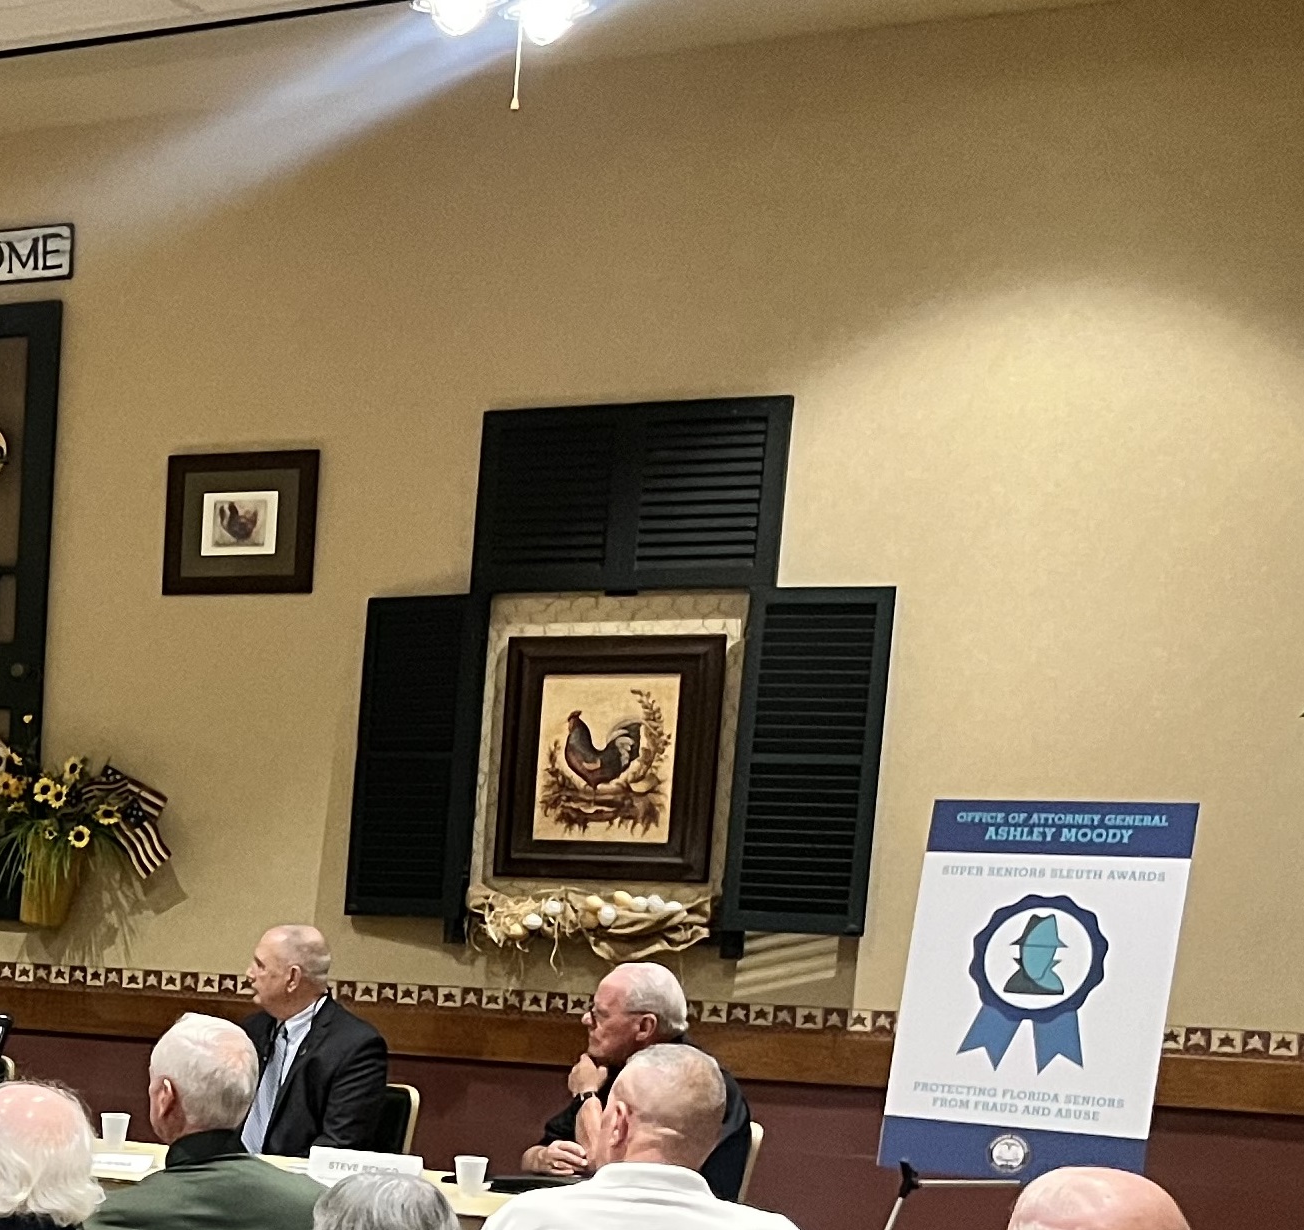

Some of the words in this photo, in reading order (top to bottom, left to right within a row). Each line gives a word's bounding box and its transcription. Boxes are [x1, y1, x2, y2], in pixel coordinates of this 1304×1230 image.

[956, 812, 1004, 823] OFFICE
[1008, 813, 1027, 824] OF
[1028, 813, 1101, 825] ATTORNEY
[1104, 815, 1169, 827] GENERAL
[984, 827, 1056, 842] ASHLEY
[1060, 828, 1133, 844] MOODY
[942, 865, 984, 877] SUPER
[987, 866, 1046, 878] SENIORS
[1050, 868, 1102, 880] SLEUTH
[1106, 869, 1166, 882] AWARDS
[913, 1081, 997, 1098] PROTECTING
[1002, 1089, 1059, 1104] FLORIDA
[1063, 1094, 1125, 1109] SENIORS
[932, 1097, 969, 1110] FROM
[973, 1100, 1018, 1114] FRAUD
[1021, 1105, 1051, 1118] AND
[1055, 1108, 1100, 1122] ABUSE
[328, 1161, 359, 1172] STEVE
